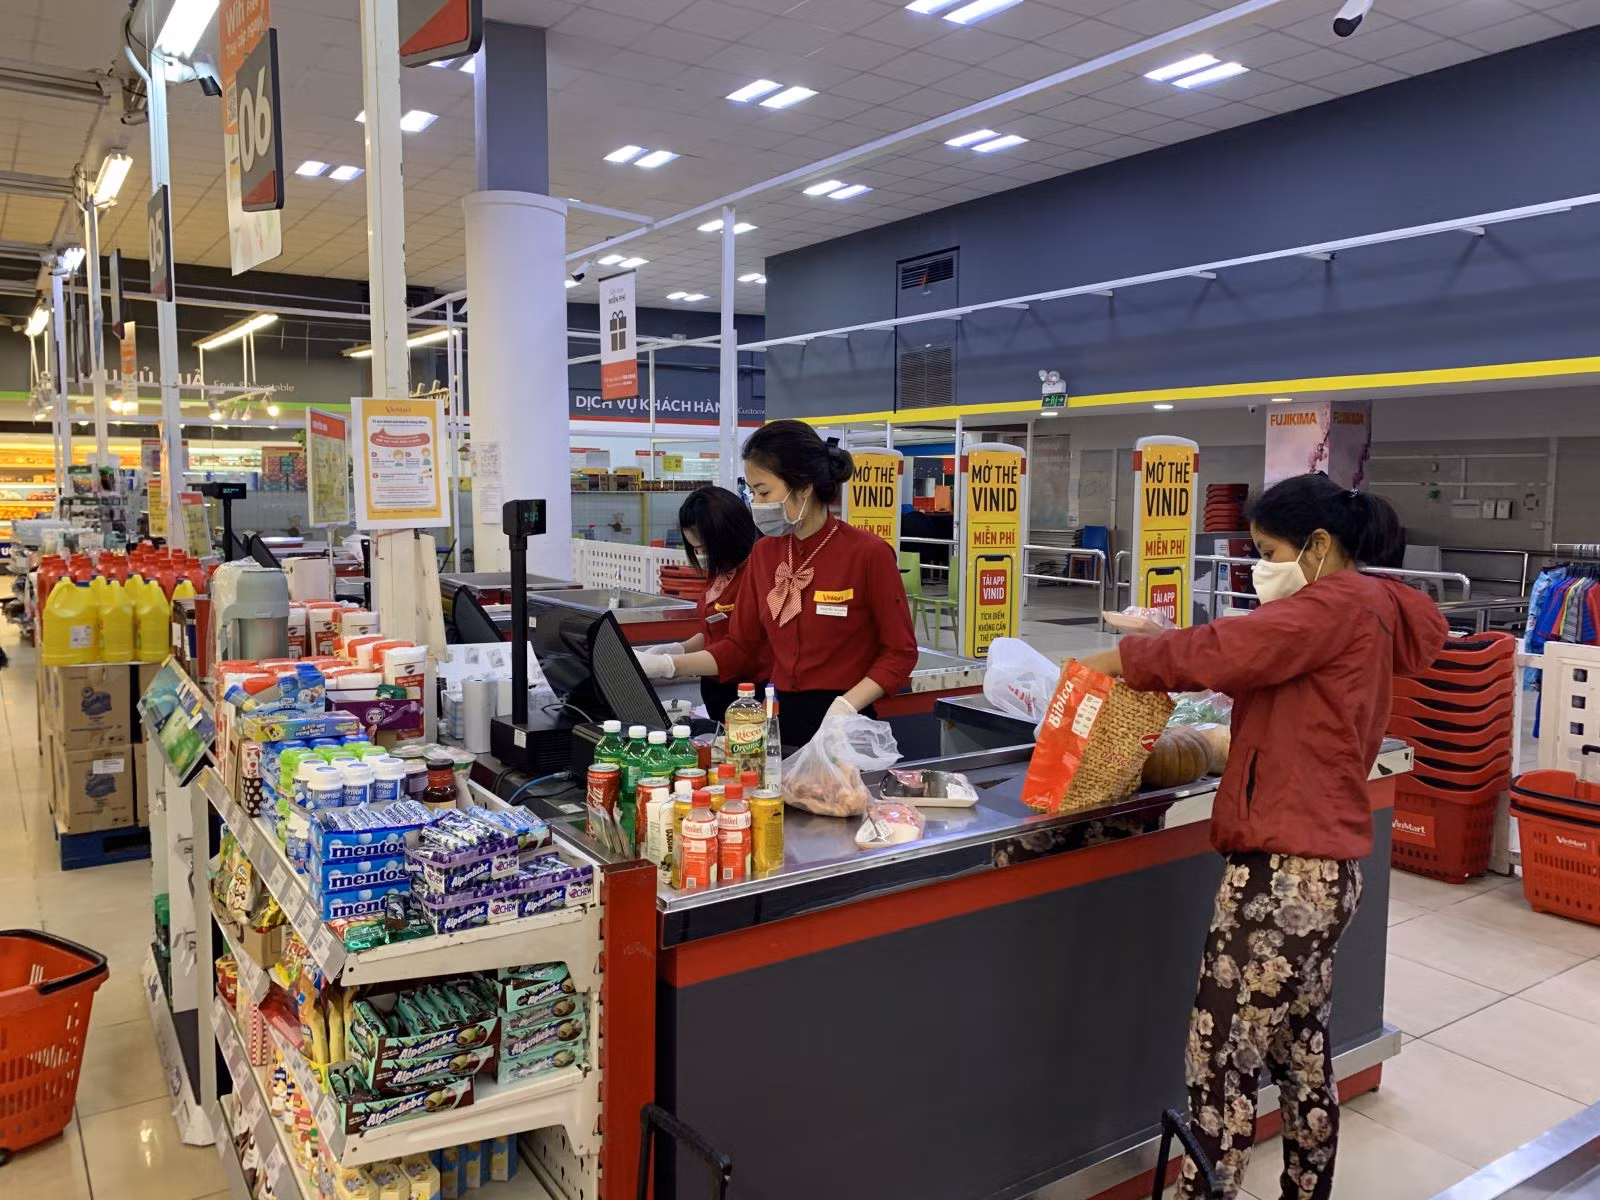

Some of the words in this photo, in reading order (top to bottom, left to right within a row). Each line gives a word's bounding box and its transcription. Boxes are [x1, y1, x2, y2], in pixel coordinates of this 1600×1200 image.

[239, 65, 272, 173] 06
[148, 207, 163, 272] 05
[575, 395, 612, 411] DỊCH
[617, 398, 637, 413] VỤ
[640, 396, 691, 413] KHÁCH
[694, 398, 721, 413] HÀN
[1270, 412, 1317, 427] FUJIKIMA
[1333, 411, 1365, 425] FUJIKIMA
[853, 461, 873, 483] MỞ
[874, 463, 895, 484] THẺ
[971, 460, 993, 484] MỞ
[995, 459, 1018, 485] THẺ
[1145, 454, 1166, 484] MỞ
[1169, 456, 1190, 483] THẺ
[853, 486, 894, 508] VINID
[972, 487, 1017, 512] VINID
[1145, 487, 1189, 517] VINID
[854, 519, 875, 536] MIỄN
[877, 524, 892, 537] PHÍ
[973, 525, 997, 545] MIỄN
[1000, 530, 1015, 545] PHÍ
[1145, 533, 1168, 556] MIỄN
[1170, 535, 1185, 555] PHÍ
[982, 573, 992, 586] TẢI
[993, 576, 1005, 585] APP
[983, 588, 1005, 600] VINID
[1163, 592, 1175, 602] APP
[1048, 680, 1075, 728] Bibica
[735, 728, 761, 741] Ricco
[733, 740, 761, 753] Organic
[1556, 835, 1587, 849] VinMart
[330, 868, 411, 889] mentos
[451, 862, 490, 888] Alpenliebe
[331, 897, 388, 918] ment
[525, 889, 563, 912] Alpenliebe
[444, 904, 485, 929] Alpenliebe
[528, 983, 561, 1005] Alpenliebe
[398, 1033, 454, 1060] Alpenliebe
[511, 1028, 556, 1055] Alpenliebe
[392, 1058, 449, 1083] Alpenliebe
[366, 1096, 423, 1127] Alpenliebe
